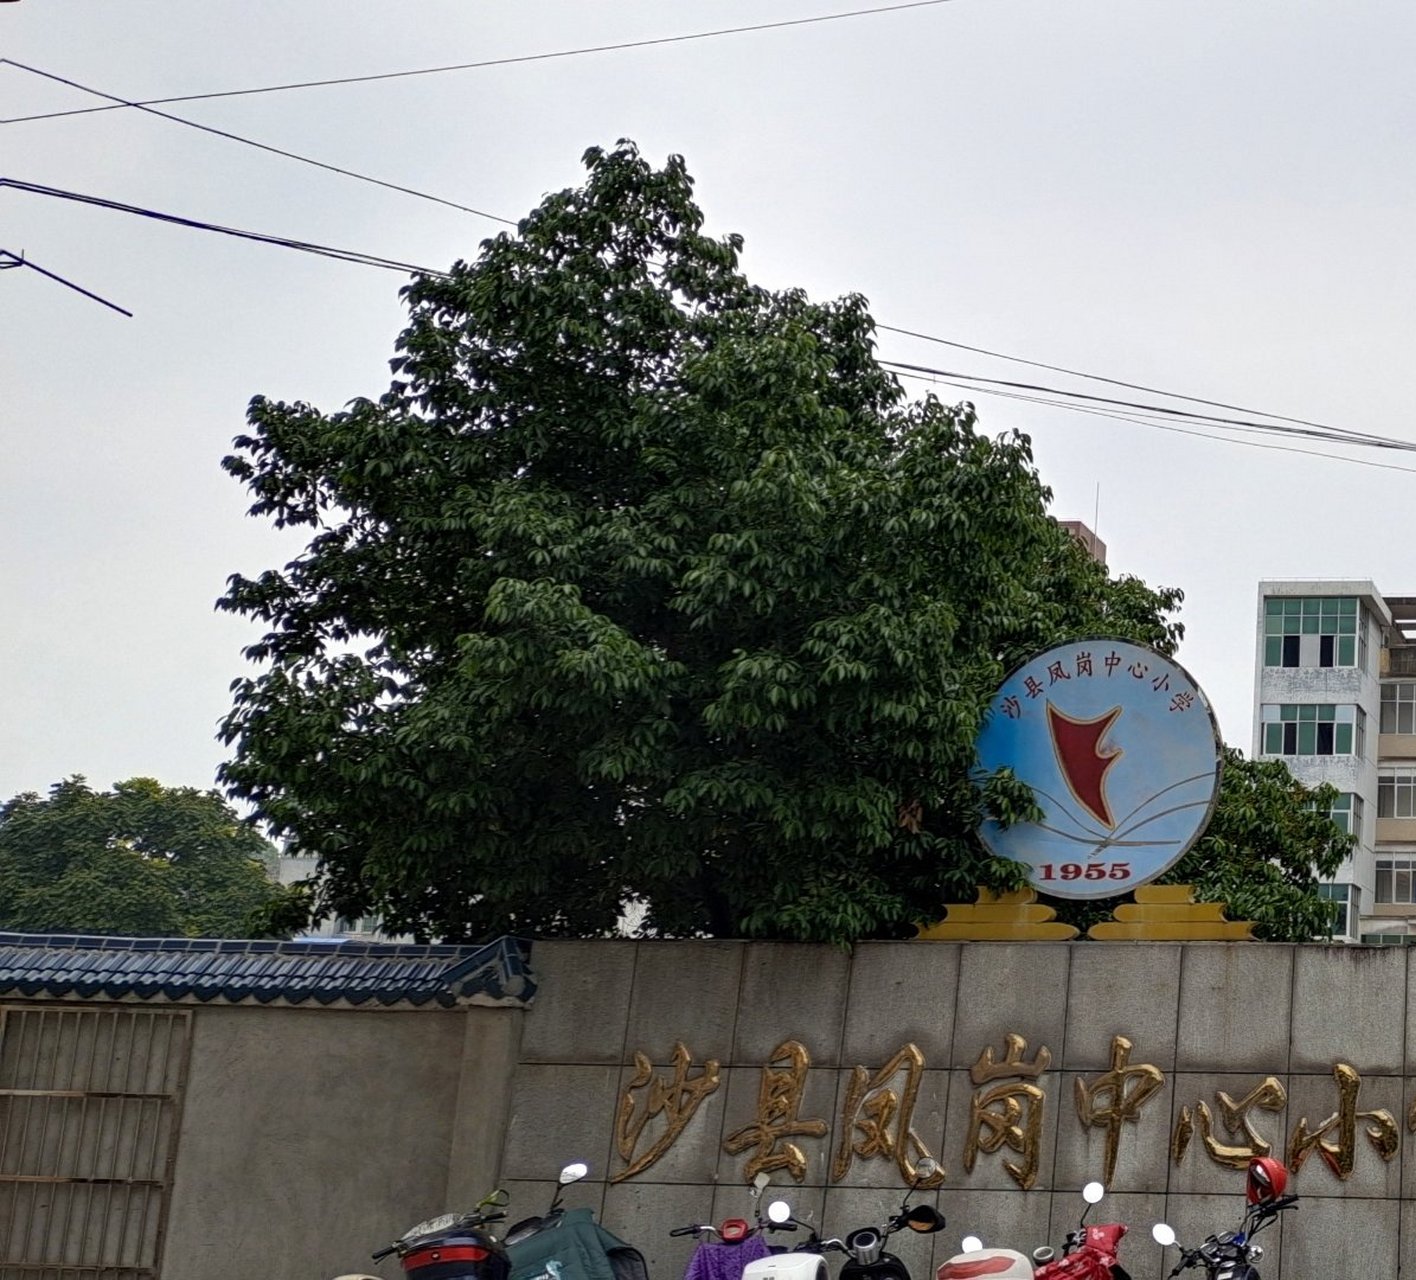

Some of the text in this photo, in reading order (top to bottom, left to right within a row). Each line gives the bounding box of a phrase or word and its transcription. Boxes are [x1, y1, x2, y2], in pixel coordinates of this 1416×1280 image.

[1000, 650, 1196, 720] 沙县凤岗中心小学
[1039, 862, 1131, 881] 1955
